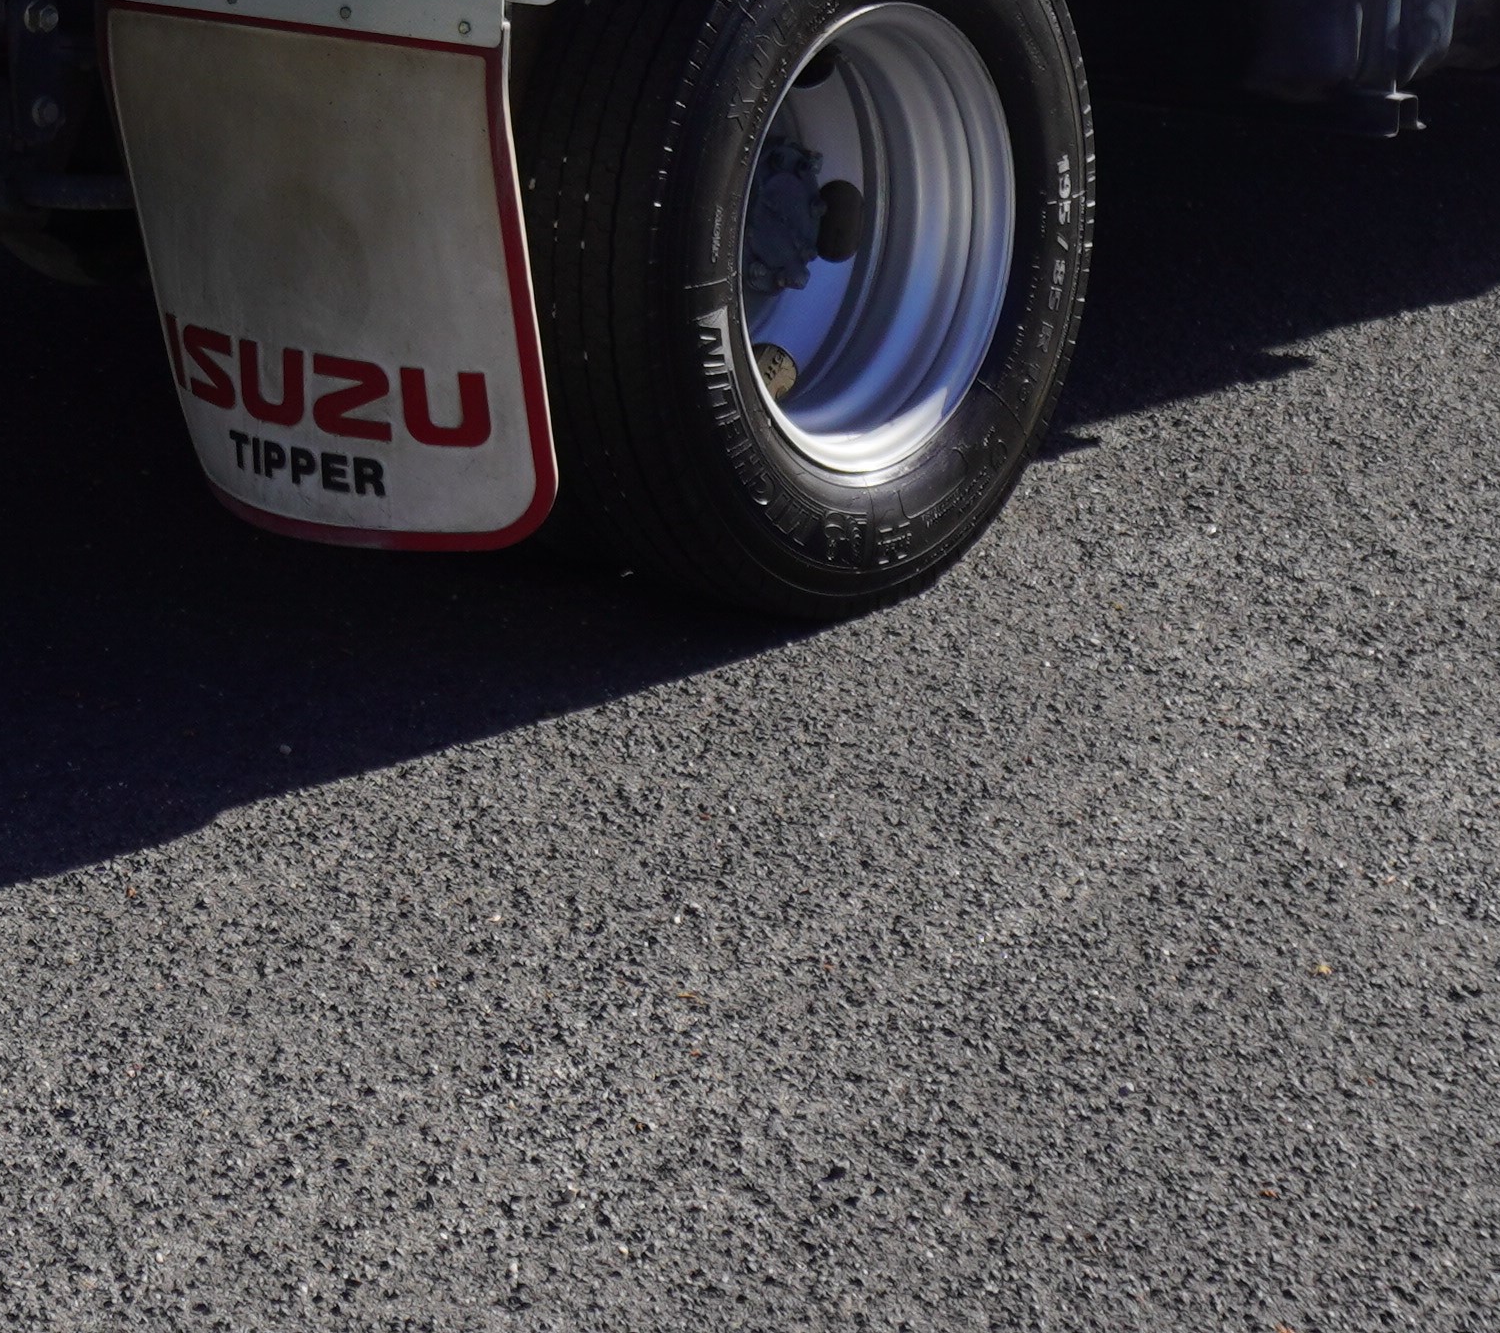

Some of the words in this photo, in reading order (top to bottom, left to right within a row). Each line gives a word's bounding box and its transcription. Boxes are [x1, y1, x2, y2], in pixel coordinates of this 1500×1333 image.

[165, 312, 492, 448] ISUZU
[697, 325, 824, 548] MICHELIN
[229, 429, 387, 497] TIPPER
